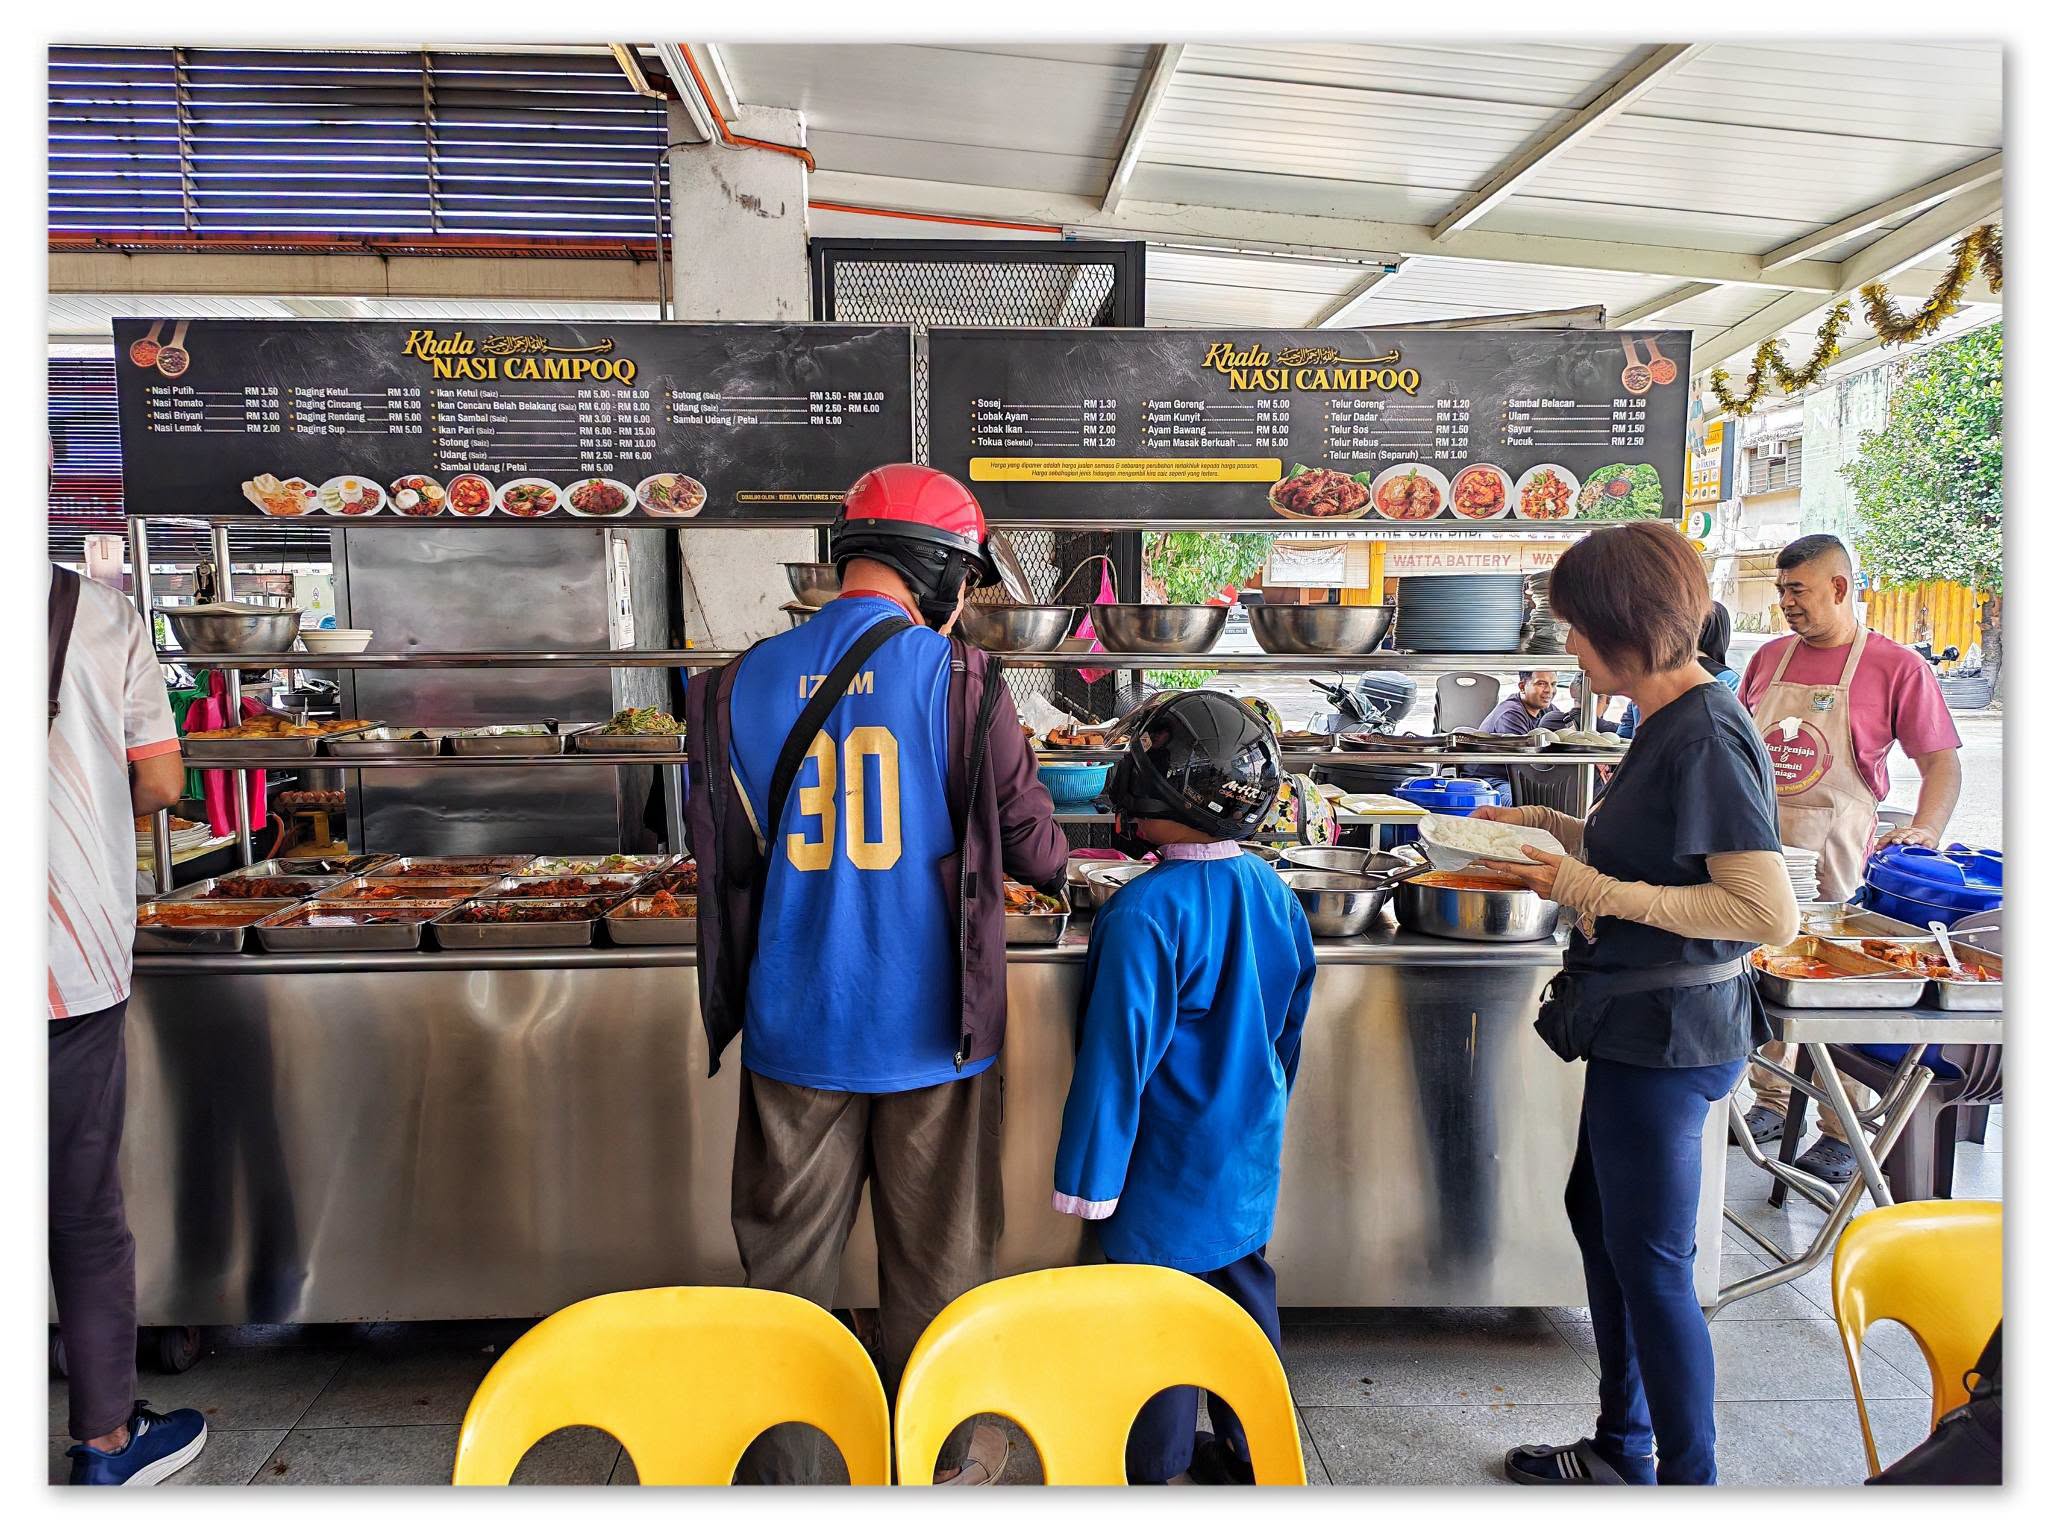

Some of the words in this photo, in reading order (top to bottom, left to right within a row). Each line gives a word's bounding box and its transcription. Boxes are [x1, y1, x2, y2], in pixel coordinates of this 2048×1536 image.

[401, 330, 475, 360] Khala
[1201, 343, 1271, 372] Khala
[433, 358, 498, 379] NASI
[504, 358, 635, 386] CAMPOQ
[1229, 369, 1289, 390] NASI
[1295, 368, 1419, 395] CAMPOQ
[152, 386, 170, 395] Nasi
[173, 386, 194, 395] Putih
[245, 387, 259, 395] RM
[261, 387, 278, 395] 1.50
[295, 387, 325, 397] Daging
[326, 387, 348, 396] Ketul
[387, 388, 401, 396] RM
[403, 388, 420, 396] 3.00
[437, 389, 454, 398] Ikan
[456, 389, 478, 398] Ketul
[578, 390, 591, 398] RM
[593, 390, 610, 398] 5.00
[617, 390, 631, 398] RM
[672, 391, 701, 401] Sotong
[810, 392, 823, 401] RM
[824, 392, 842, 401] 3.50
[848, 392, 861, 401] RM
[863, 392, 884, 401] 10.00
[153, 399, 171, 407] Nasi
[174, 399, 204, 407] Tomato
[246, 399, 260, 408] RM
[262, 399, 279, 408] 3.00
[295, 400, 326, 410] Daging
[327, 400, 361, 410] Cincang
[388, 401, 402, 409] RM
[404, 401, 421, 409] 5.00
[437, 401, 455, 410] Ikan
[456, 402, 491, 410] Cencaru
[493, 402, 516, 410] Belah
[518, 402, 557, 412] Belakang
[578, 402, 592, 410] RM
[618, 402, 631, 410] RM
[673, 403, 699, 413] Udang
[810, 404, 823, 413] RM
[825, 404, 842, 413] 2.50
[848, 404, 862, 413] RM
[863, 404, 880, 413] 6.00
[977, 398, 1001, 409] Sosej
[1084, 400, 1097, 408] RM
[1099, 400, 1116, 408] 1.30
[1148, 400, 1172, 410] Ayam
[1174, 400, 1204, 410] Goreng
[1257, 400, 1271, 409] RM
[1272, 400, 1290, 409] 5.00
[1332, 400, 1352, 408] Telur
[1354, 400, 1385, 410] Goreng
[1437, 400, 1451, 408] RM
[1452, 400, 1470, 408] 1.20
[1509, 399, 1539, 408] Sambal
[1542, 399, 1575, 408] Belacan
[1613, 399, 1627, 408] RM
[1629, 399, 1646, 408] 1.50
[296, 412, 326, 422] Daging
[328, 412, 366, 422] Rendang
[389, 413, 402, 421] RM
[404, 413, 421, 421] 5.00
[438, 413, 456, 422] Ikan
[458, 413, 488, 422] Sambal
[579, 415, 592, 423] RM
[594, 415, 611, 423] 3.00
[618, 415, 631, 423] RM
[978, 412, 1003, 421] Lobak
[1005, 412, 1028, 422] Ayam
[1084, 413, 1097, 421] RM
[1099, 413, 1116, 421] 2.00
[1148, 413, 1171, 423] Ayam
[1174, 413, 1200, 423] Kunyit
[1257, 413, 1270, 422] RM
[1272, 413, 1289, 422] 5.00
[1331, 412, 1351, 421] Telur
[1353, 412, 1378, 421] Dadar
[1437, 412, 1450, 421] RM
[1452, 412, 1469, 421] 1.50
[1509, 412, 1530, 420] Ulam
[1613, 412, 1626, 420] RM
[1628, 412, 1646, 420] 1.50
[154, 424, 172, 432] Nasi
[175, 424, 202, 432] Lemak
[247, 424, 261, 433] RM
[263, 424, 280, 433] 2.00
[439, 426, 456, 434] Ikan
[458, 426, 474, 434] Pari
[579, 427, 592, 435] RM
[619, 427, 632, 435] RM
[634, 427, 655, 435] 15.00
[978, 424, 1003, 433] Lobak
[1006, 424, 1022, 433] Ikan
[1084, 425, 1097, 434] RM
[1099, 425, 1116, 434] 2.00
[1148, 426, 1171, 436] Ayam
[1173, 426, 1206, 436] Bawang
[1256, 426, 1270, 434] RM
[1330, 425, 1351, 434] Telur
[1353, 425, 1369, 434] Sos
[1436, 425, 1450, 434] RM
[978, 438, 1002, 446] Tokua
[1084, 438, 1097, 446] RM
[1099, 438, 1116, 446] 1.20
[1148, 438, 1171, 448] Ayam
[1173, 438, 1199, 447] Masak
[1201, 438, 1235, 447] Berkuah
[1256, 438, 1269, 446] RM
[1272, 438, 1288, 446] 5.00
[1507, 437, 1534, 446] Pucuk
[1612, 437, 1625, 446] RM
[1627, 437, 1644, 446] 2.50
[1330, 451, 1350, 459] Telur
[1352, 451, 1376, 459] Masin
[1378, 450, 1419, 460] (Separuh)
[1435, 451, 1448, 459] RM
[1450, 451, 1468, 459] 1.00
[441, 463, 471, 472] Sambal
[473, 463, 500, 473] Udang
[506, 463, 527, 472] Petai
[1393, 554, 1442, 568] WATTA
[1446, 554, 1511, 568] BATTERY
[800, 671, 874, 699] IZM
[1782, 745, 1815, 757] Penjaja
[786, 726, 904, 872] 30
